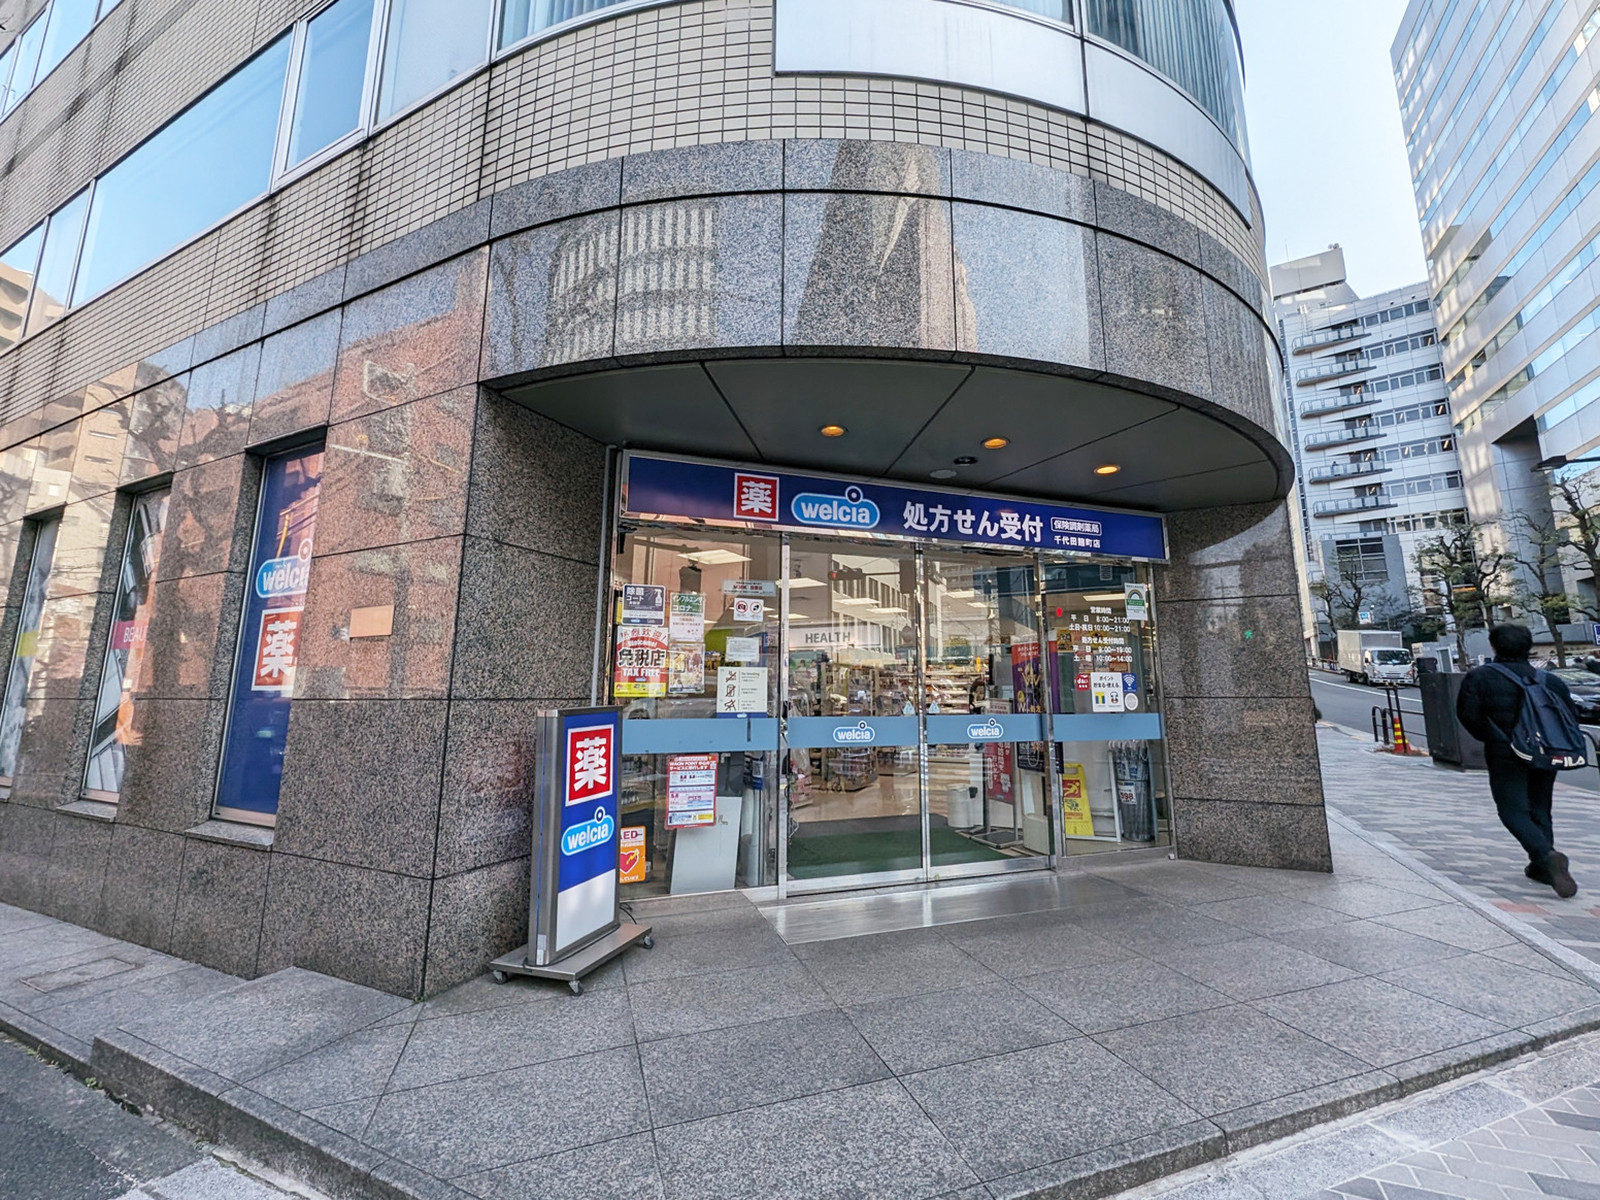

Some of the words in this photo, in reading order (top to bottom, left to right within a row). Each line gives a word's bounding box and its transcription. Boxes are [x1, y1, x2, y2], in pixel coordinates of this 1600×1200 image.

[741, 481, 772, 514] 薬
[800, 491, 871, 525] welcia
[902, 501, 1044, 543] 処方せん受付
[1053, 519, 1100, 535] 保険調剤薬局
[673, 604, 692, 612] コロナ
[805, 632, 851, 644] HEALTH
[260, 620, 297, 678] 薬
[618, 648, 666, 667] 免税店
[623, 668, 639, 677] TAX
[836, 725, 872, 741] welcia
[969, 721, 1000, 737] welcia
[573, 736, 607, 792] 薬
[1551, 755, 1586, 768] FILA
[566, 815, 609, 851] welcia
